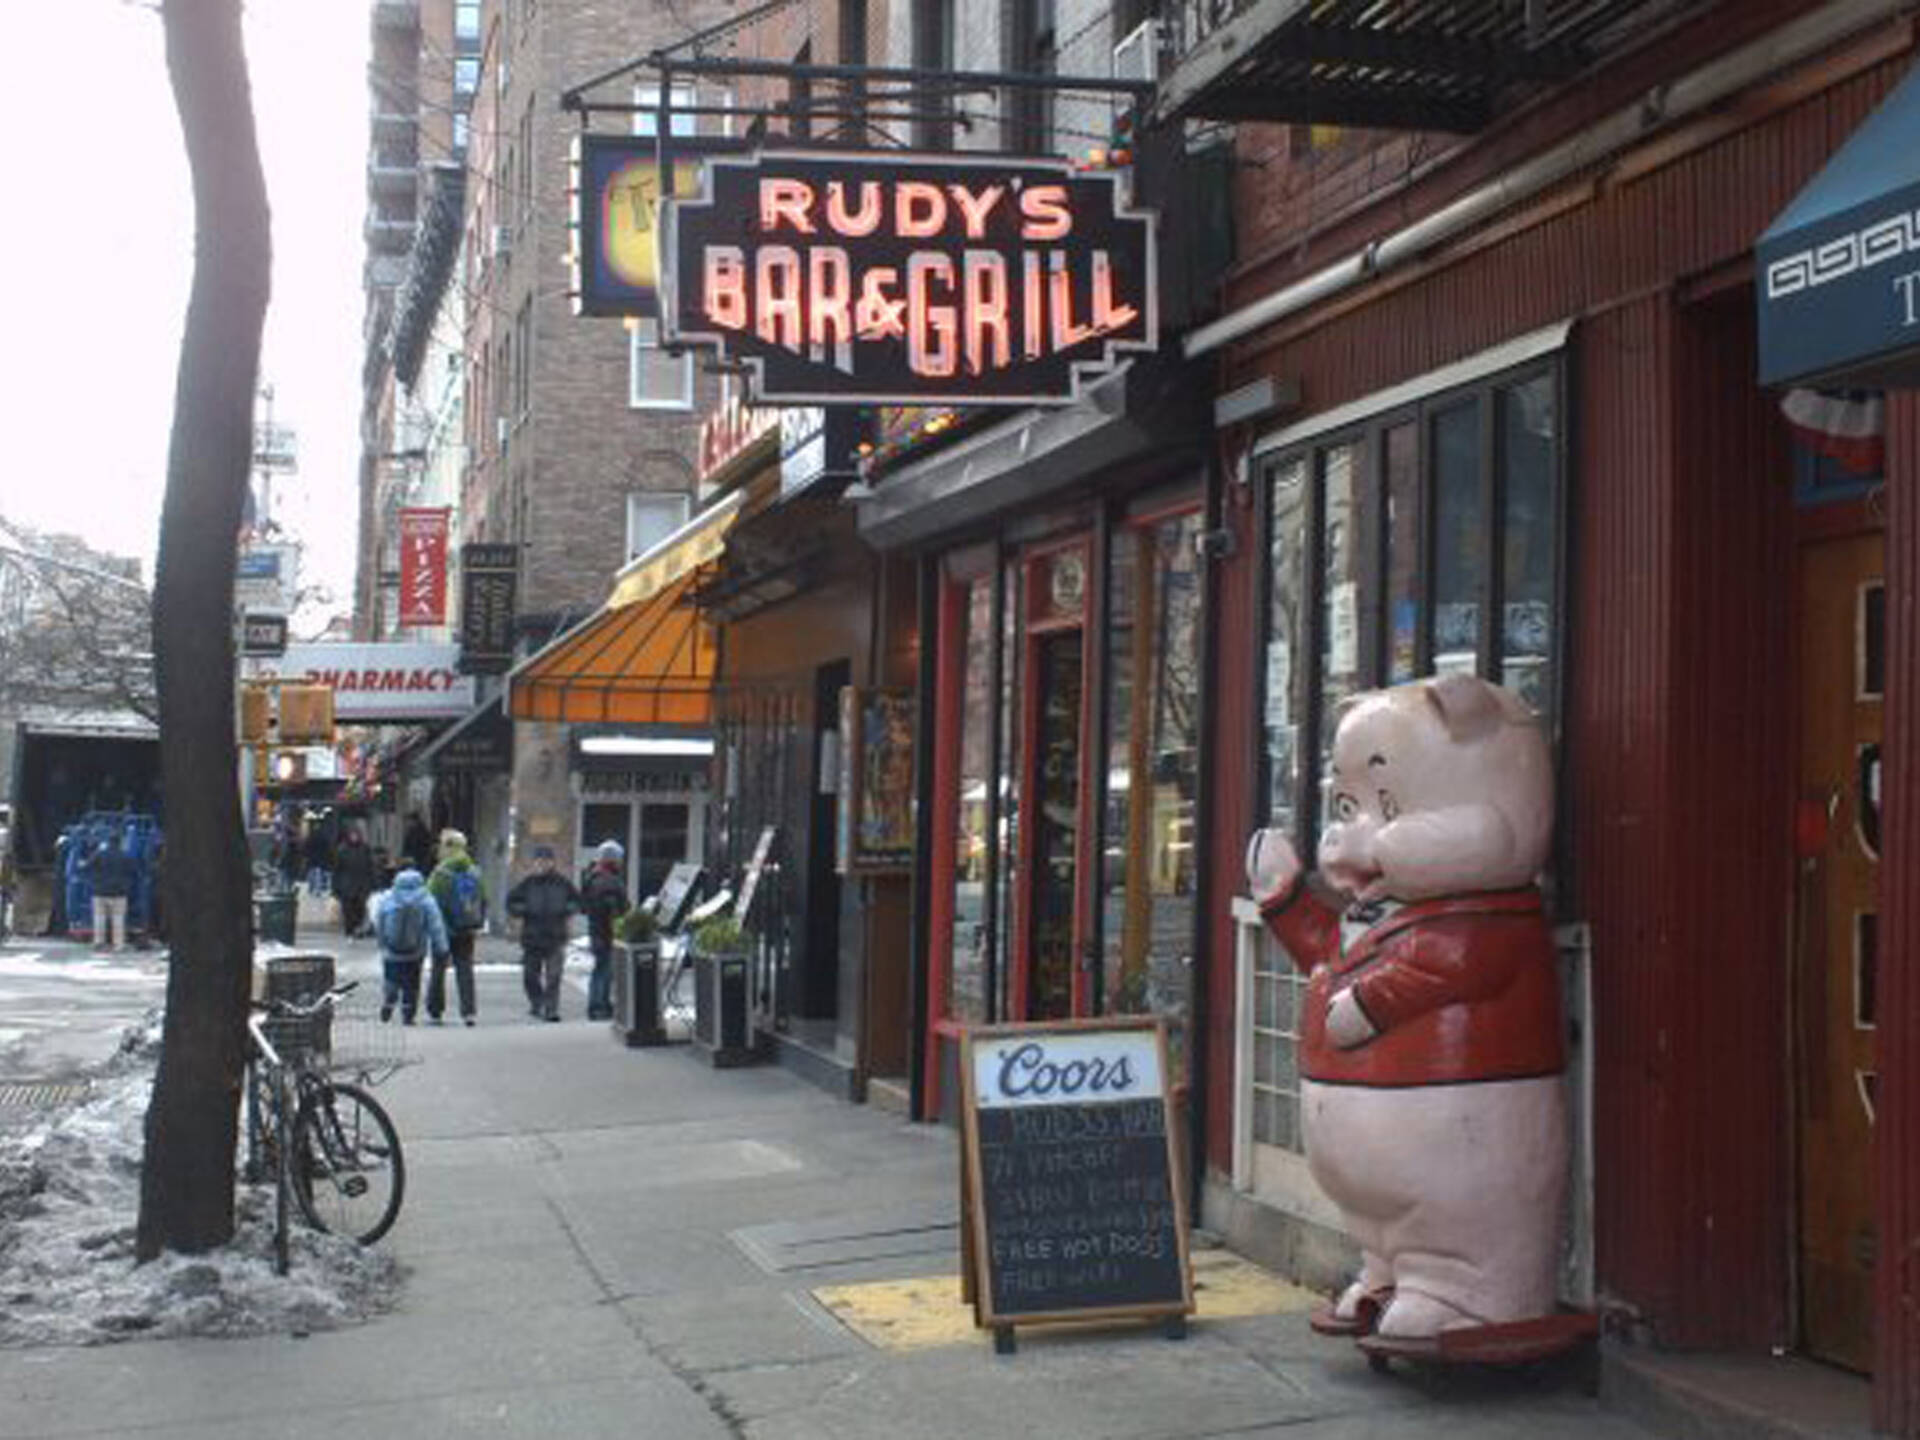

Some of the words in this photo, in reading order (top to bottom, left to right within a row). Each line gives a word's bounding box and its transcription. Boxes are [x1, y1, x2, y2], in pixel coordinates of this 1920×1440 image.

[759, 175, 1074, 241] RUDY'S
[411, 537, 437, 616] PIZZA
[304, 668, 455, 695] PHARMACY
[998, 1043, 1134, 1098] Coors
